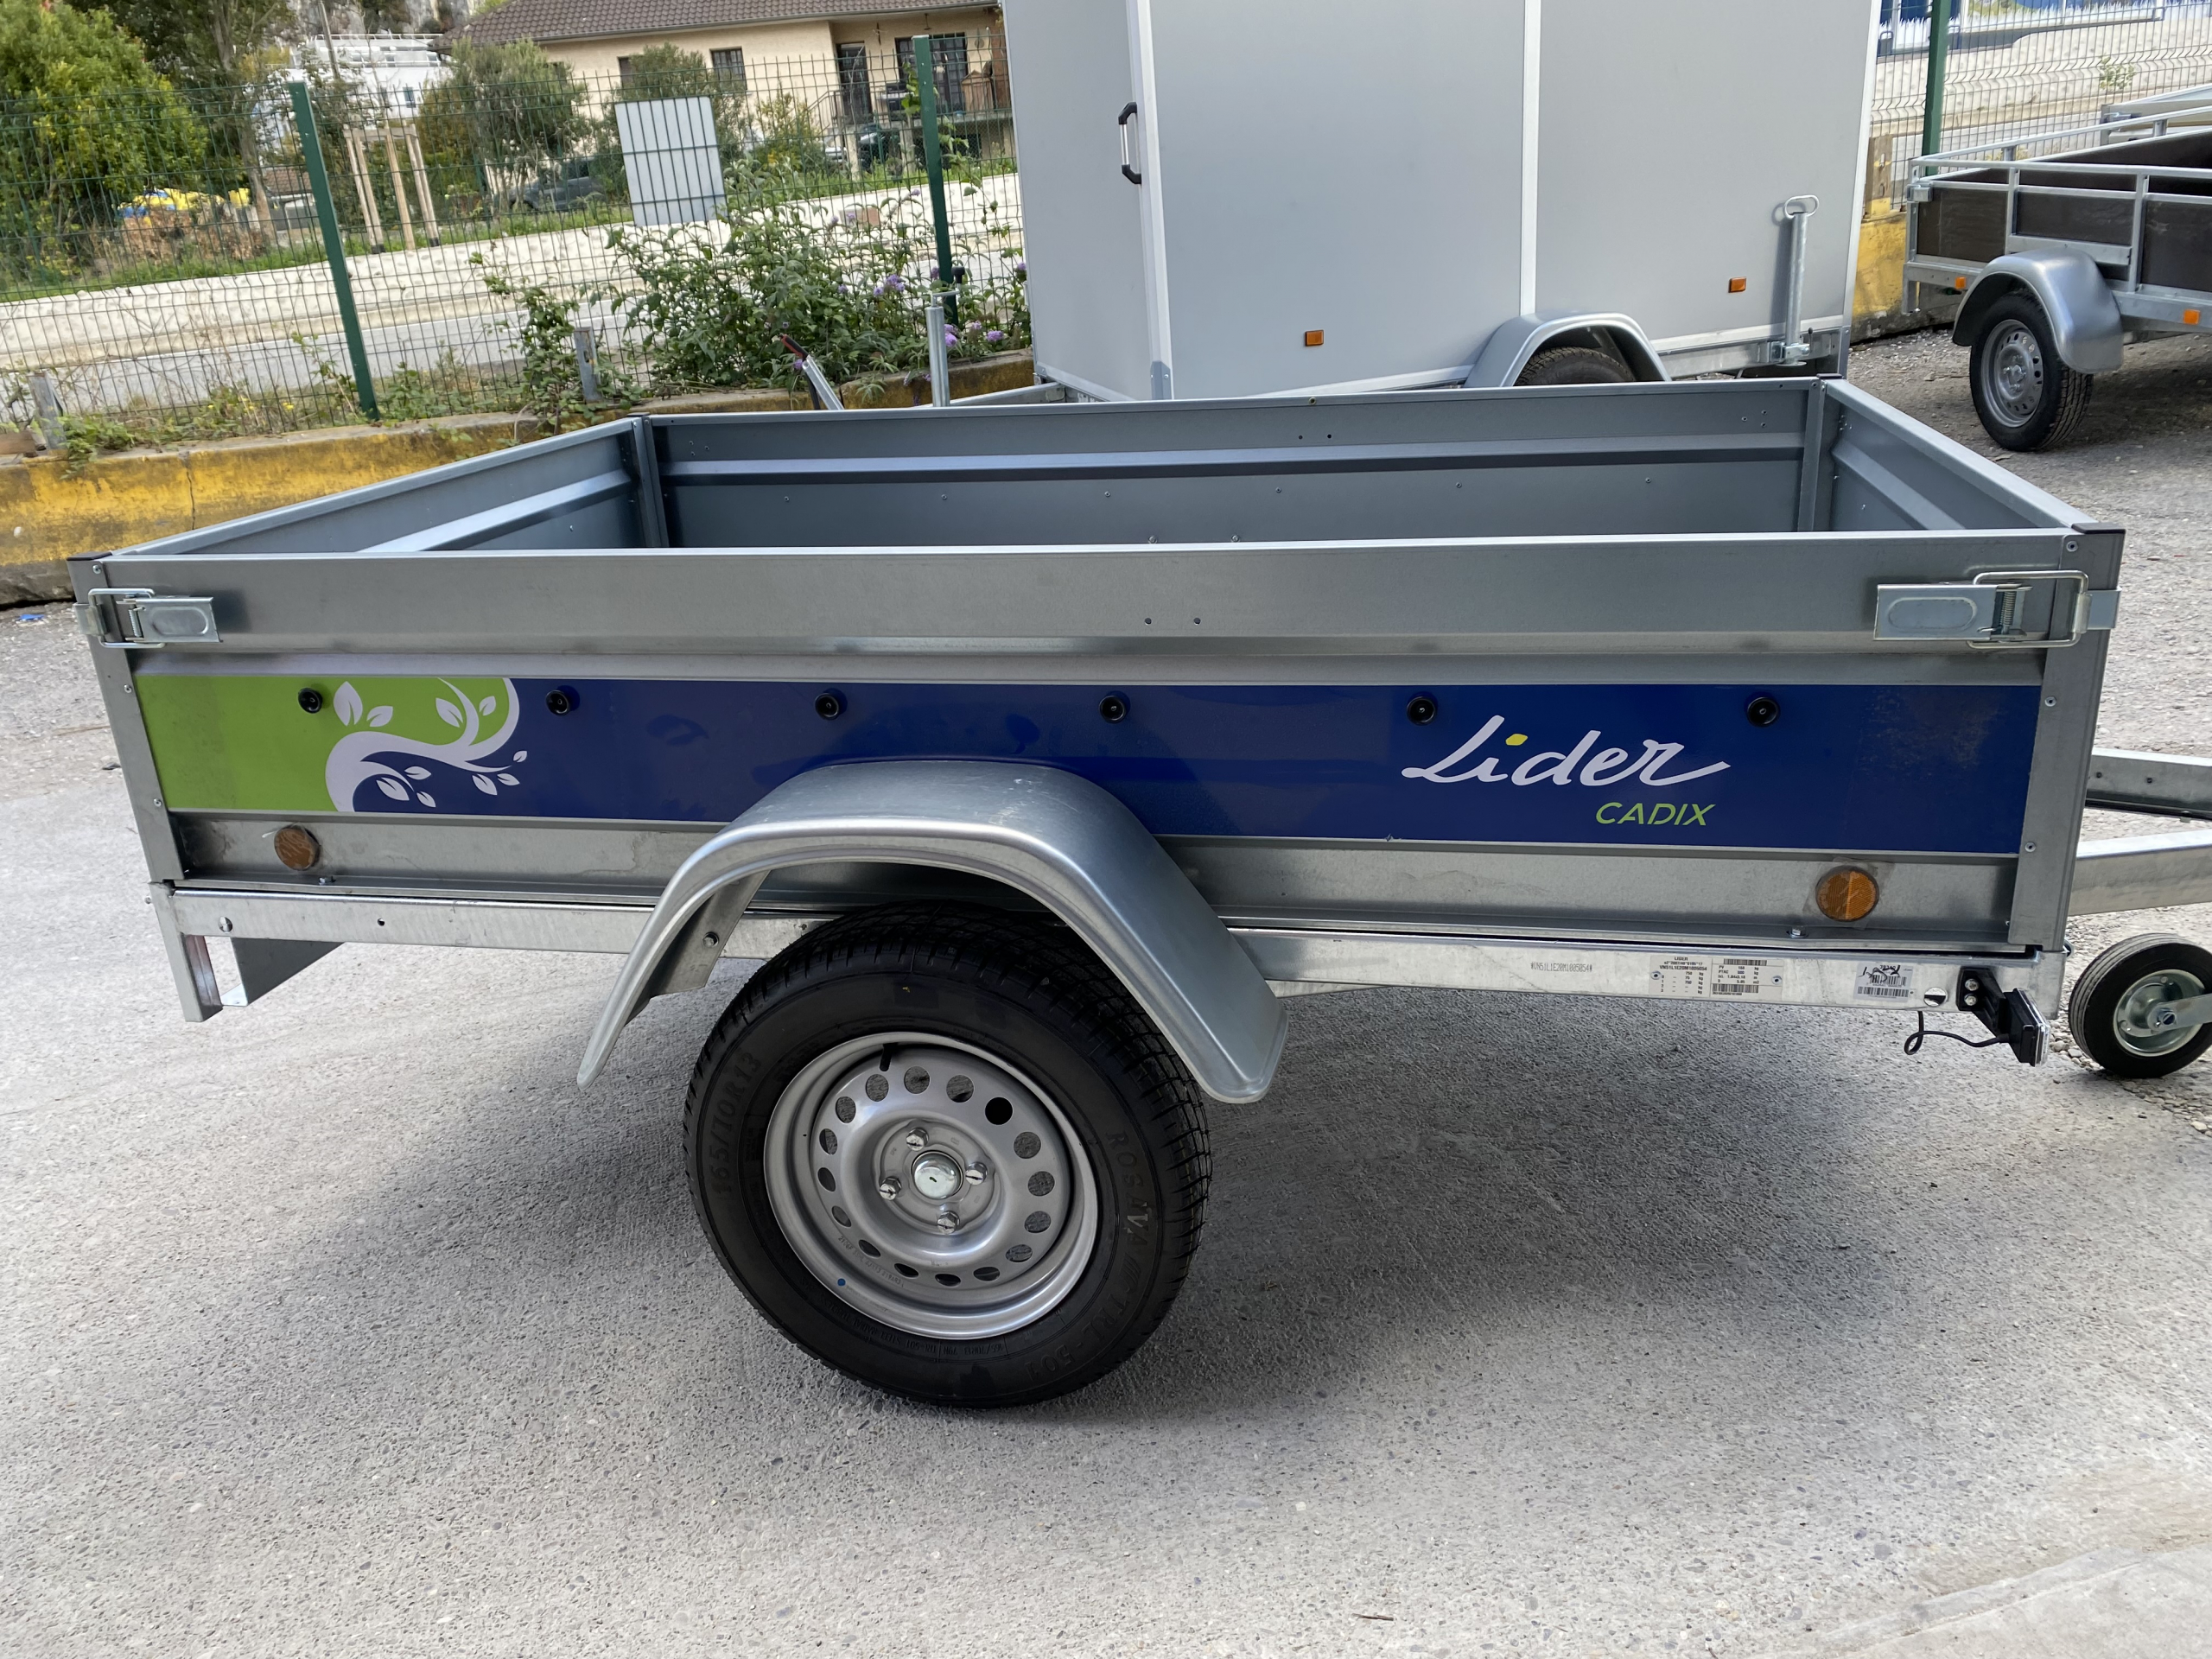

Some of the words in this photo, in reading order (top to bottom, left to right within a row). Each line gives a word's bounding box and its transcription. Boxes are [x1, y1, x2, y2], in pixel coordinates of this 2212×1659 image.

[1401, 715, 1731, 787] Lider
[1595, 802, 1715, 826] CADIX
[709, 1052, 761, 1193] 165/70R13
[1105, 1132, 1149, 1246] ROSAVA
